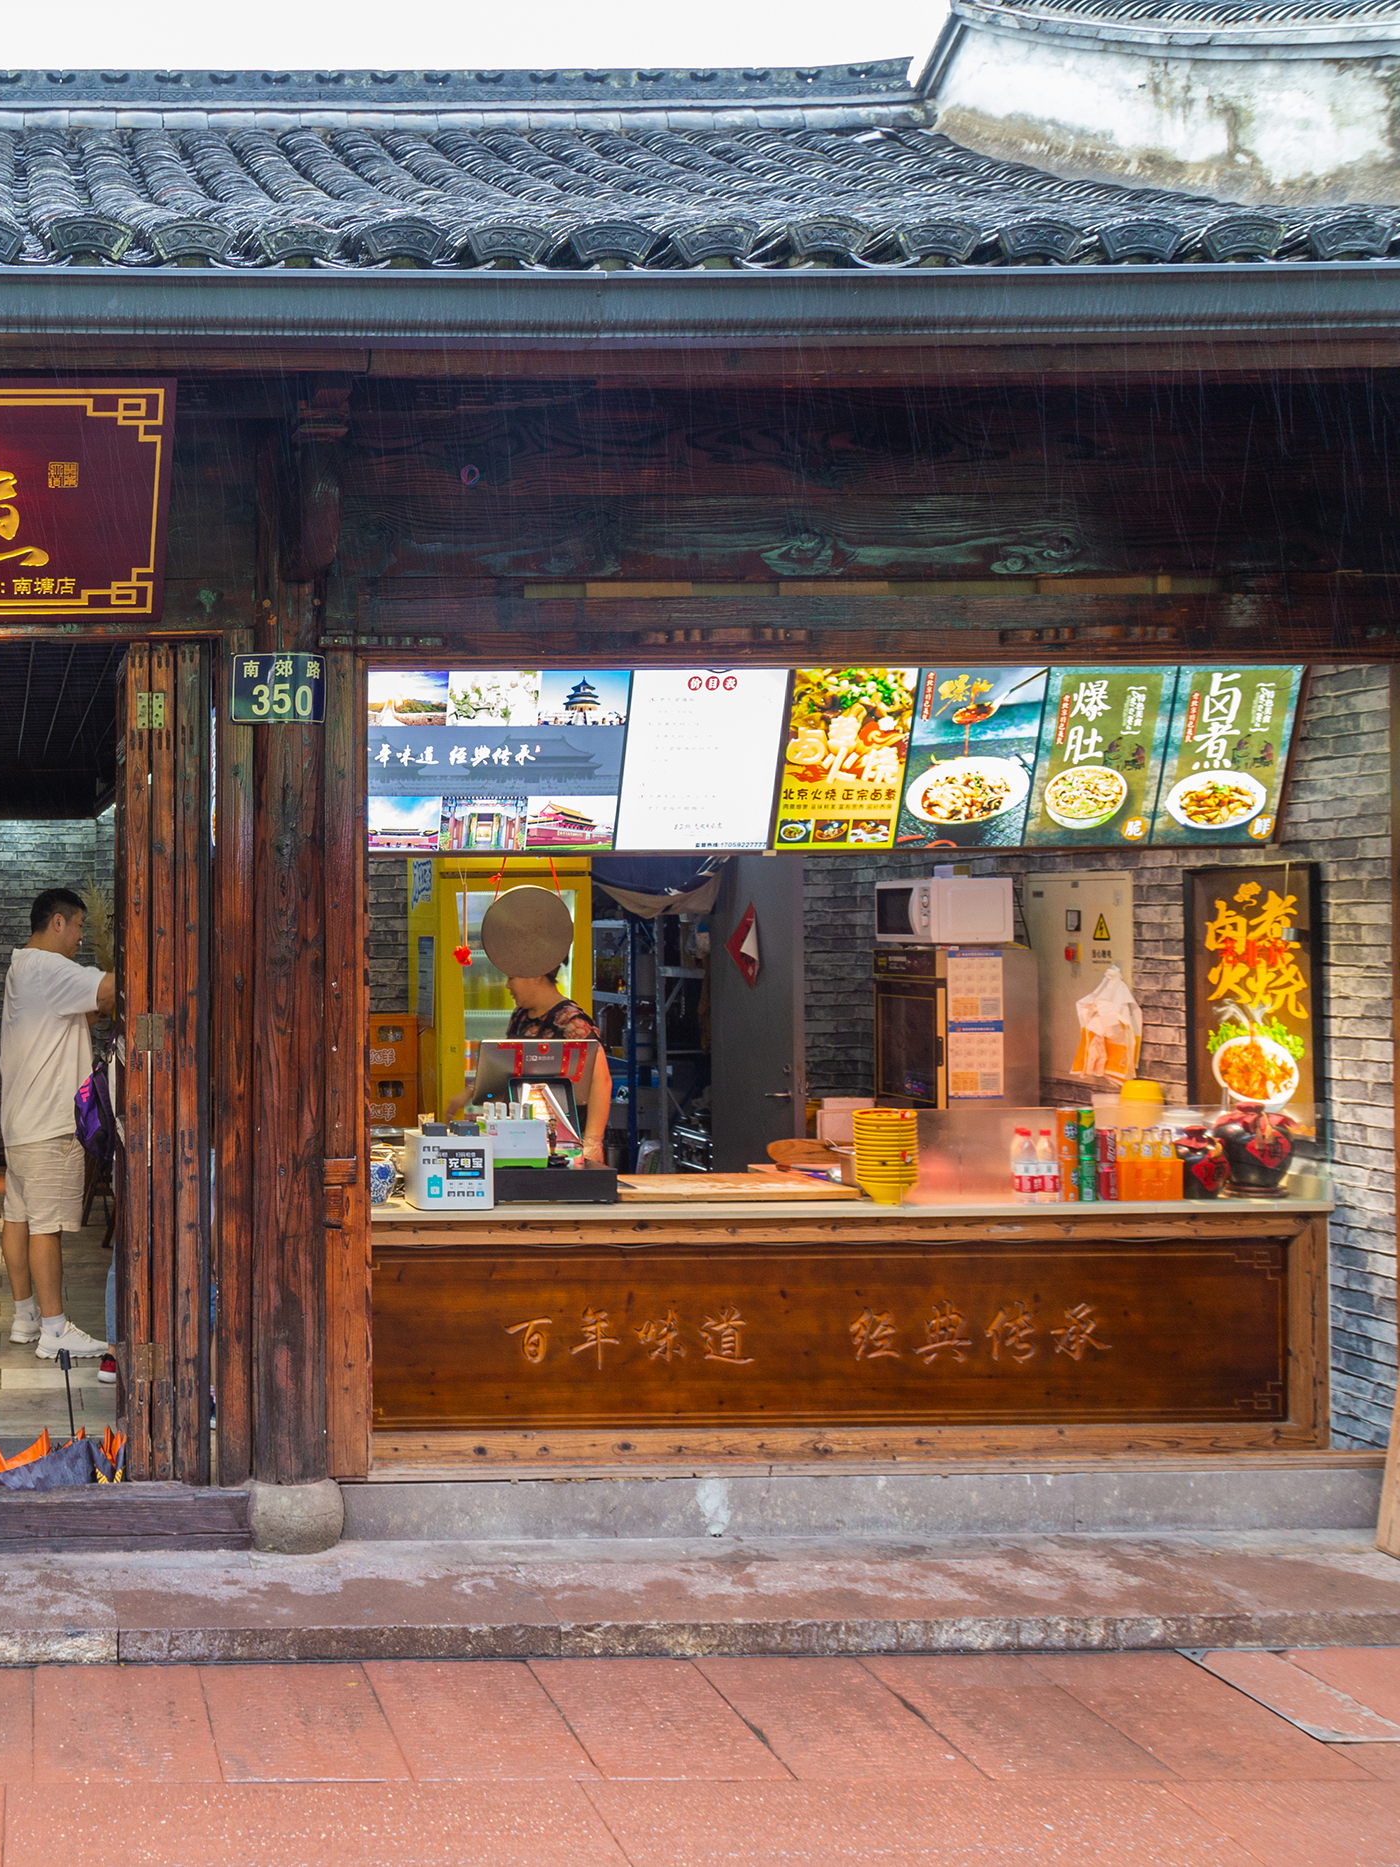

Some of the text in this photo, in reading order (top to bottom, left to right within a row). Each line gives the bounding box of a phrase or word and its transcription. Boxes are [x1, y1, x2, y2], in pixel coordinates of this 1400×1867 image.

[11, 576, 76, 595] 南塘店
[242, 659, 321, 679] 南郊路
[689, 676, 737, 691] 价目表
[251, 683, 313, 717] 350
[1063, 679, 1111, 765] 爆肚
[1191, 672, 1242, 770] 卤煮
[367, 744, 536, 768] 年味道 经典传承
[822, 747, 899, 784] 火烧
[783, 788, 897, 801] 北京火烧 正宗卤煮
[1122, 819, 1144, 840] 脆
[1251, 816, 1273, 838] 鲜
[1207, 957, 1309, 1020] 火烧
[448, 1157, 483, 1168] 充电宝
[503, 1299, 1113, 1370] 百年味道 经典传承
